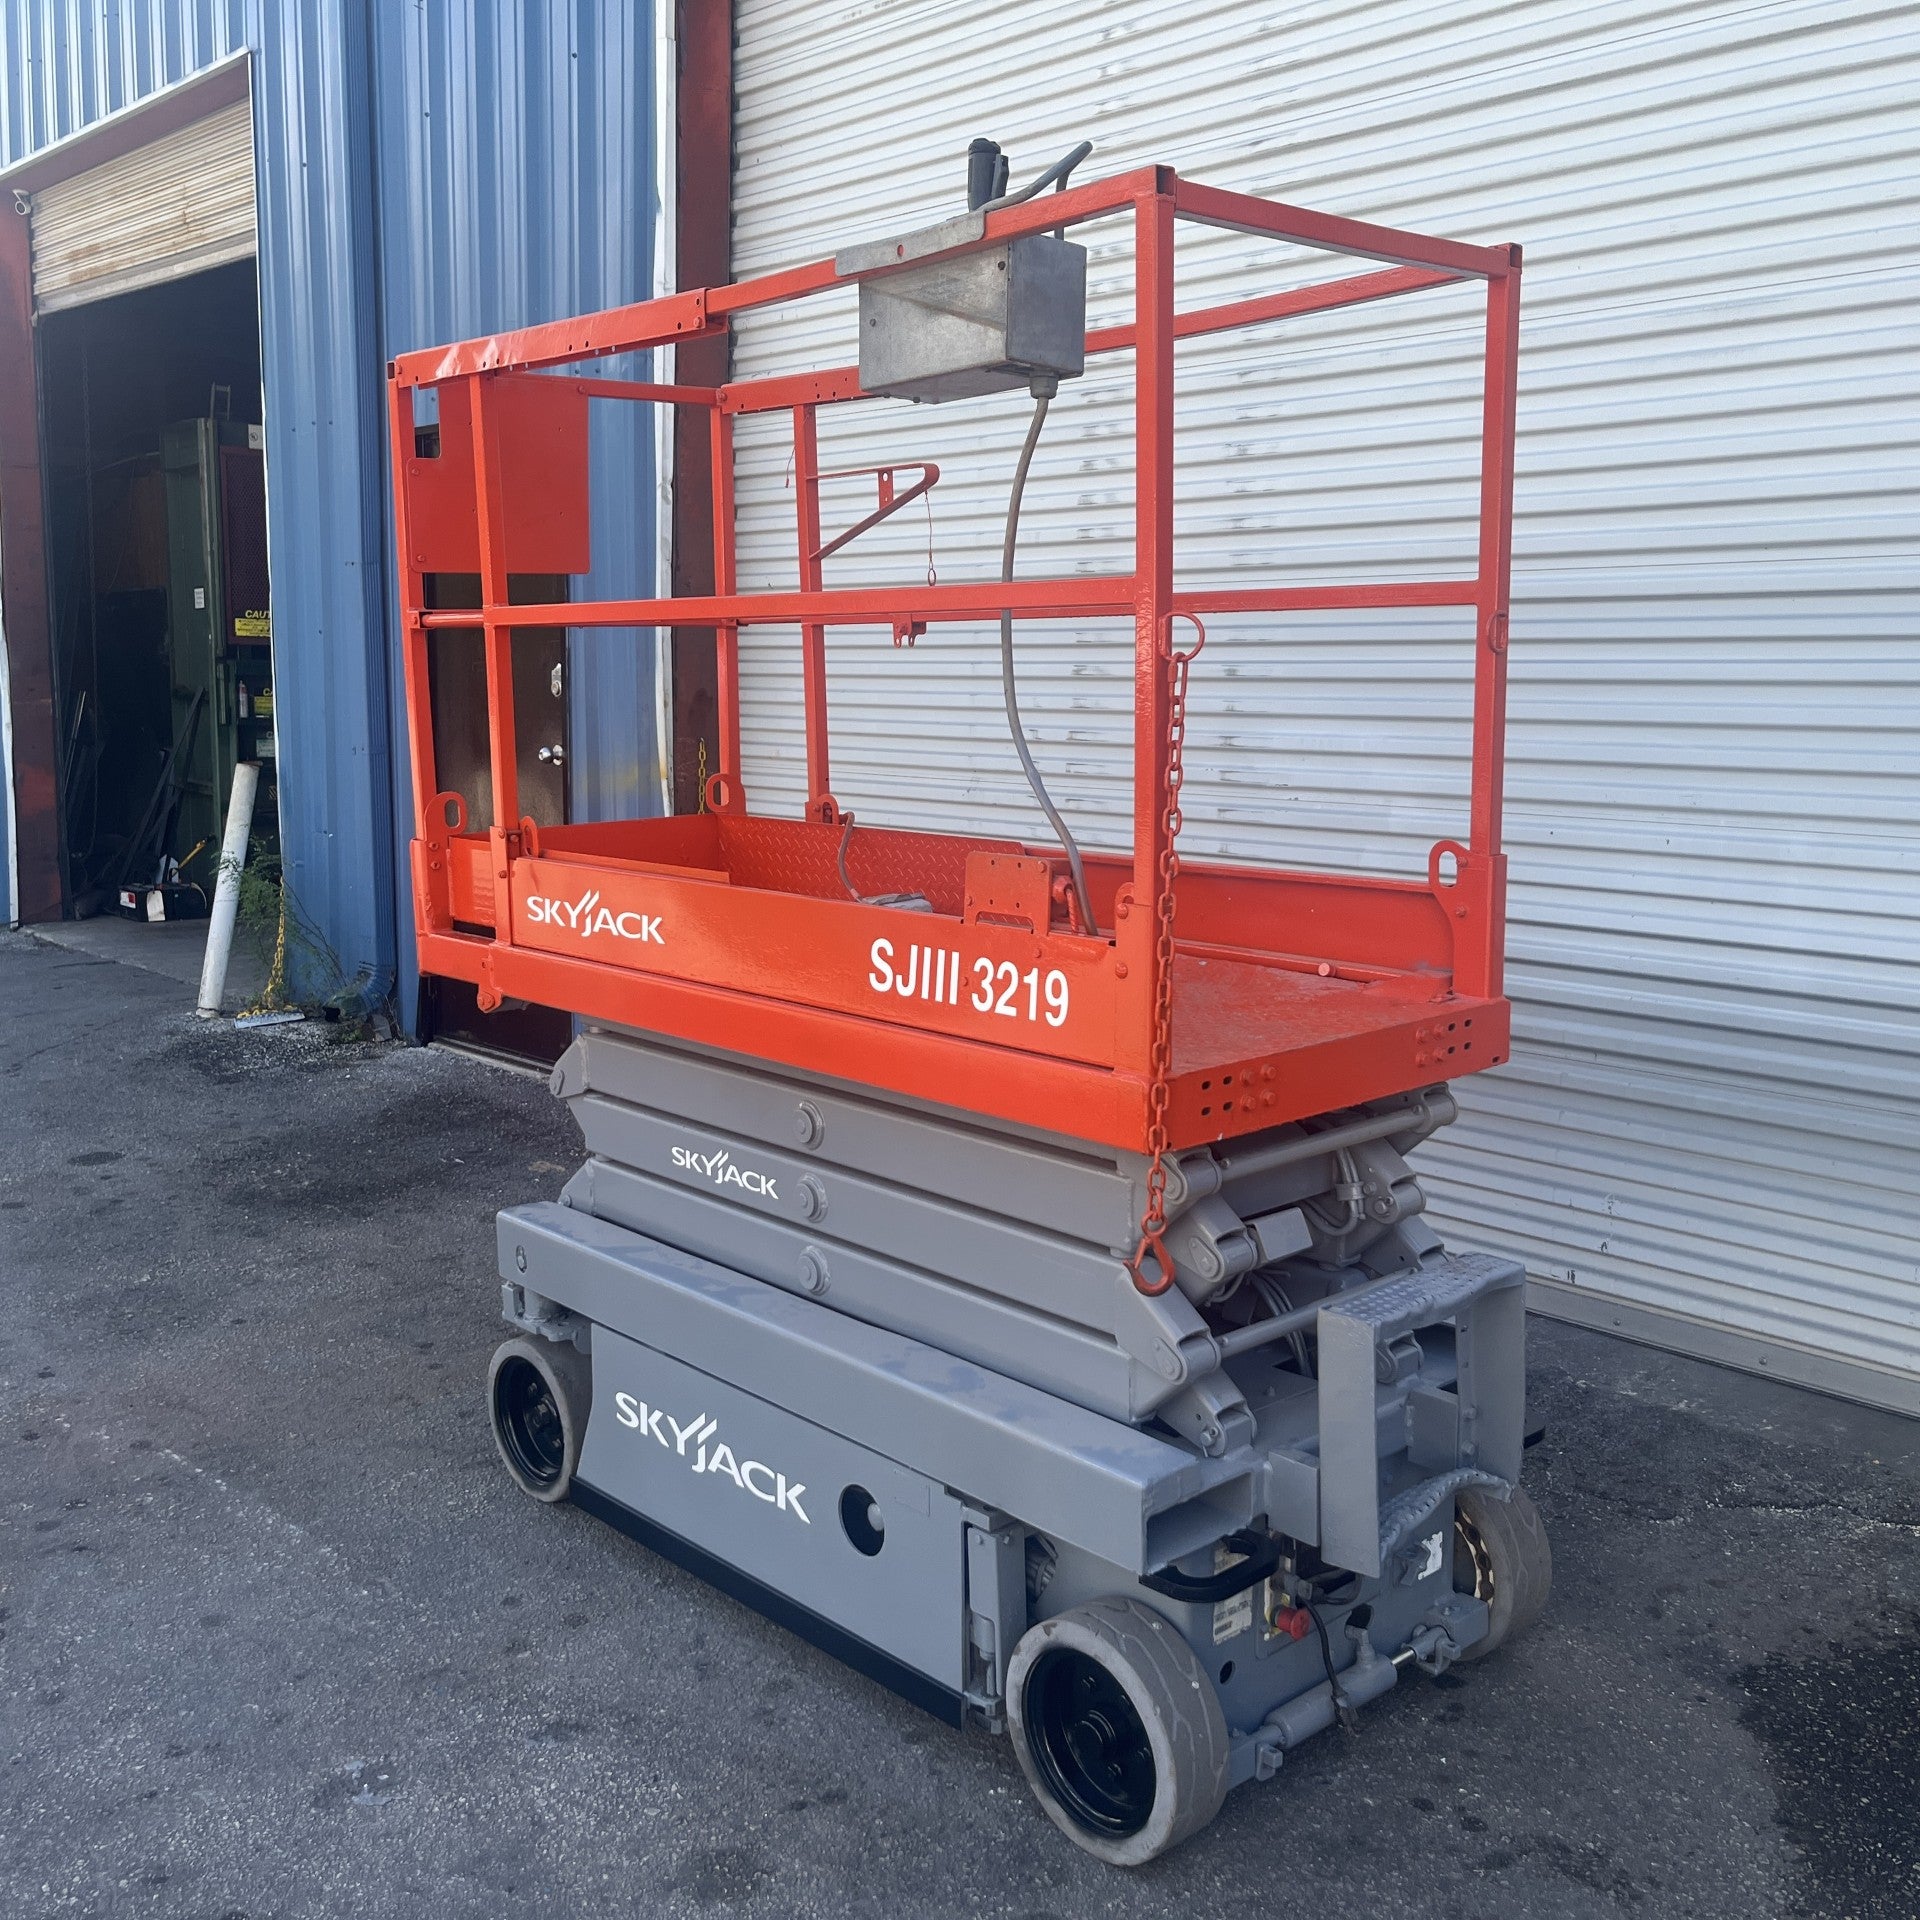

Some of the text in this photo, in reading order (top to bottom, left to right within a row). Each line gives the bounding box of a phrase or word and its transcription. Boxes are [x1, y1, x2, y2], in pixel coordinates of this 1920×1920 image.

[526, 889, 666, 945] SKYJACK
[868, 937, 1069, 1027] SJIII 3219
[671, 1146, 779, 1200] SKYJACK
[615, 1391, 811, 1524] SKYJACK
